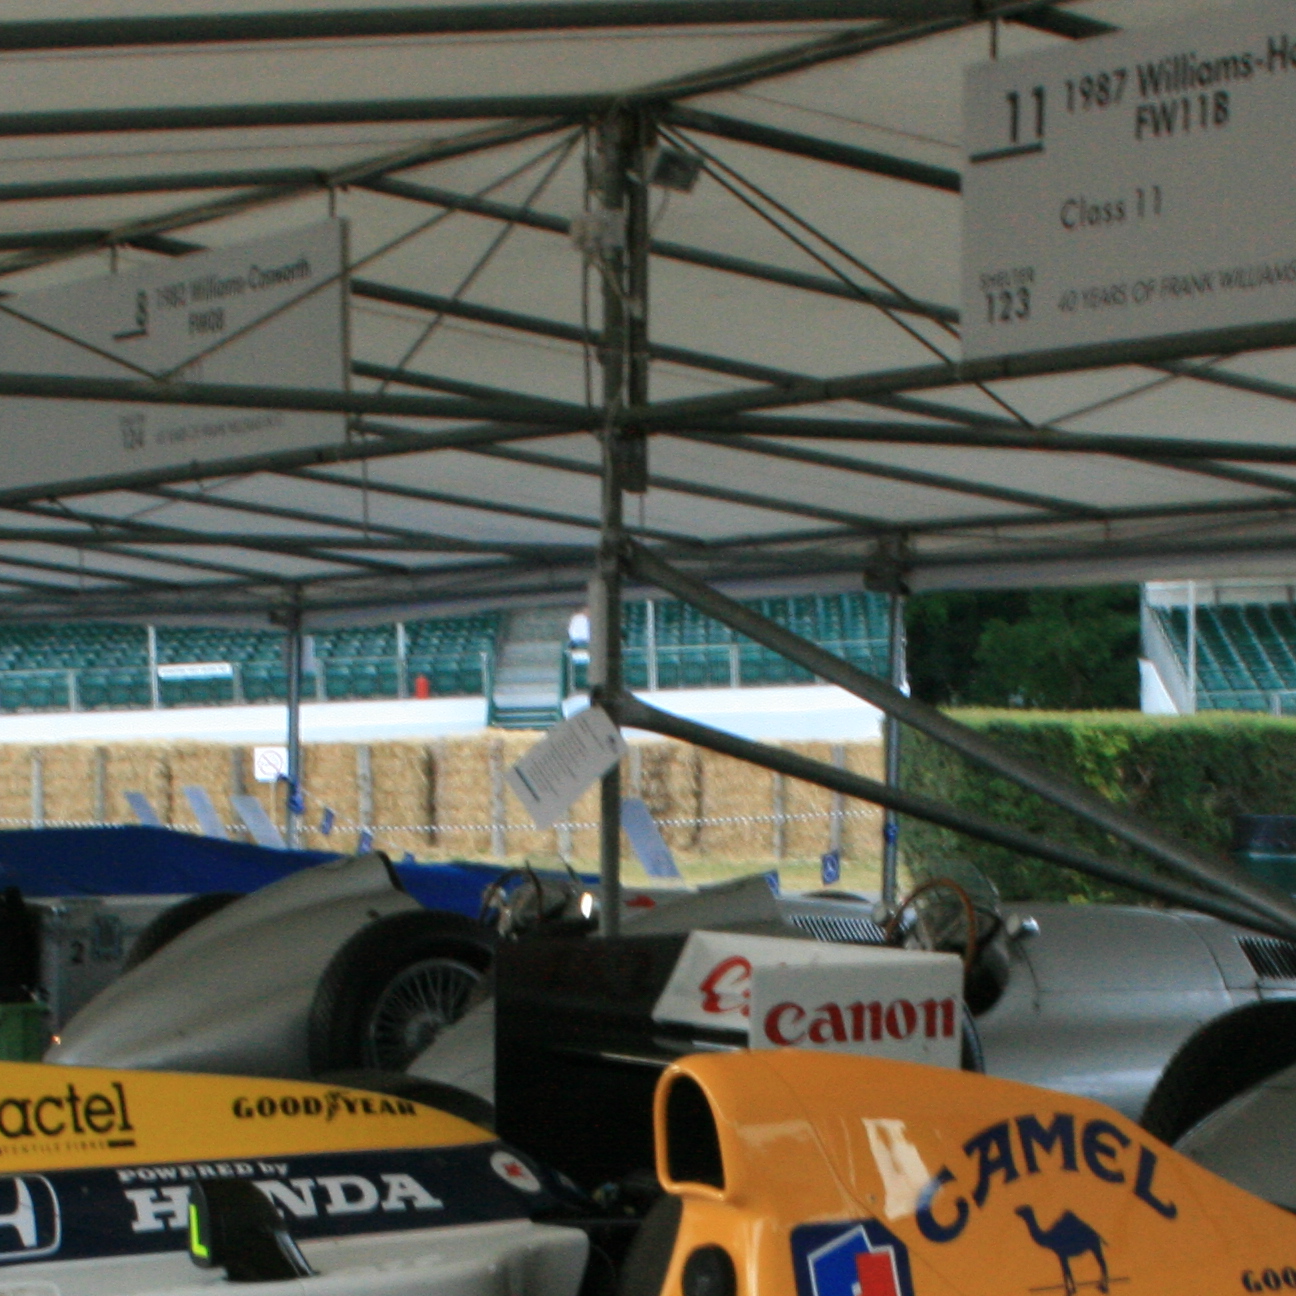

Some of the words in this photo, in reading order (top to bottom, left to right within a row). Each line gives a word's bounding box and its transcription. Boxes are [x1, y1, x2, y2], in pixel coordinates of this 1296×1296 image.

[1006, 86, 1047, 144] 11
[1063, 68, 1129, 115] 1987
[1134, 90, 1231, 140] FW11B
[1059, 196, 1125, 231] Class
[1135, 184, 1163, 218] 11
[980, 266, 1036, 291] SHELTER
[1081, 282, 1128, 309] YEARS
[1134, 279, 1155, 304] OF
[1161, 270, 1214, 298] FRANK
[986, 287, 1032, 325] 123
[232, 1090, 417, 1122] GOODYEAR
[116, 1161, 254, 1185] POWERED
[258, 1160, 289, 1177] by
[916, 1113, 1178, 1244] CAMEL
[124, 1172, 446, 1234] HNDA
